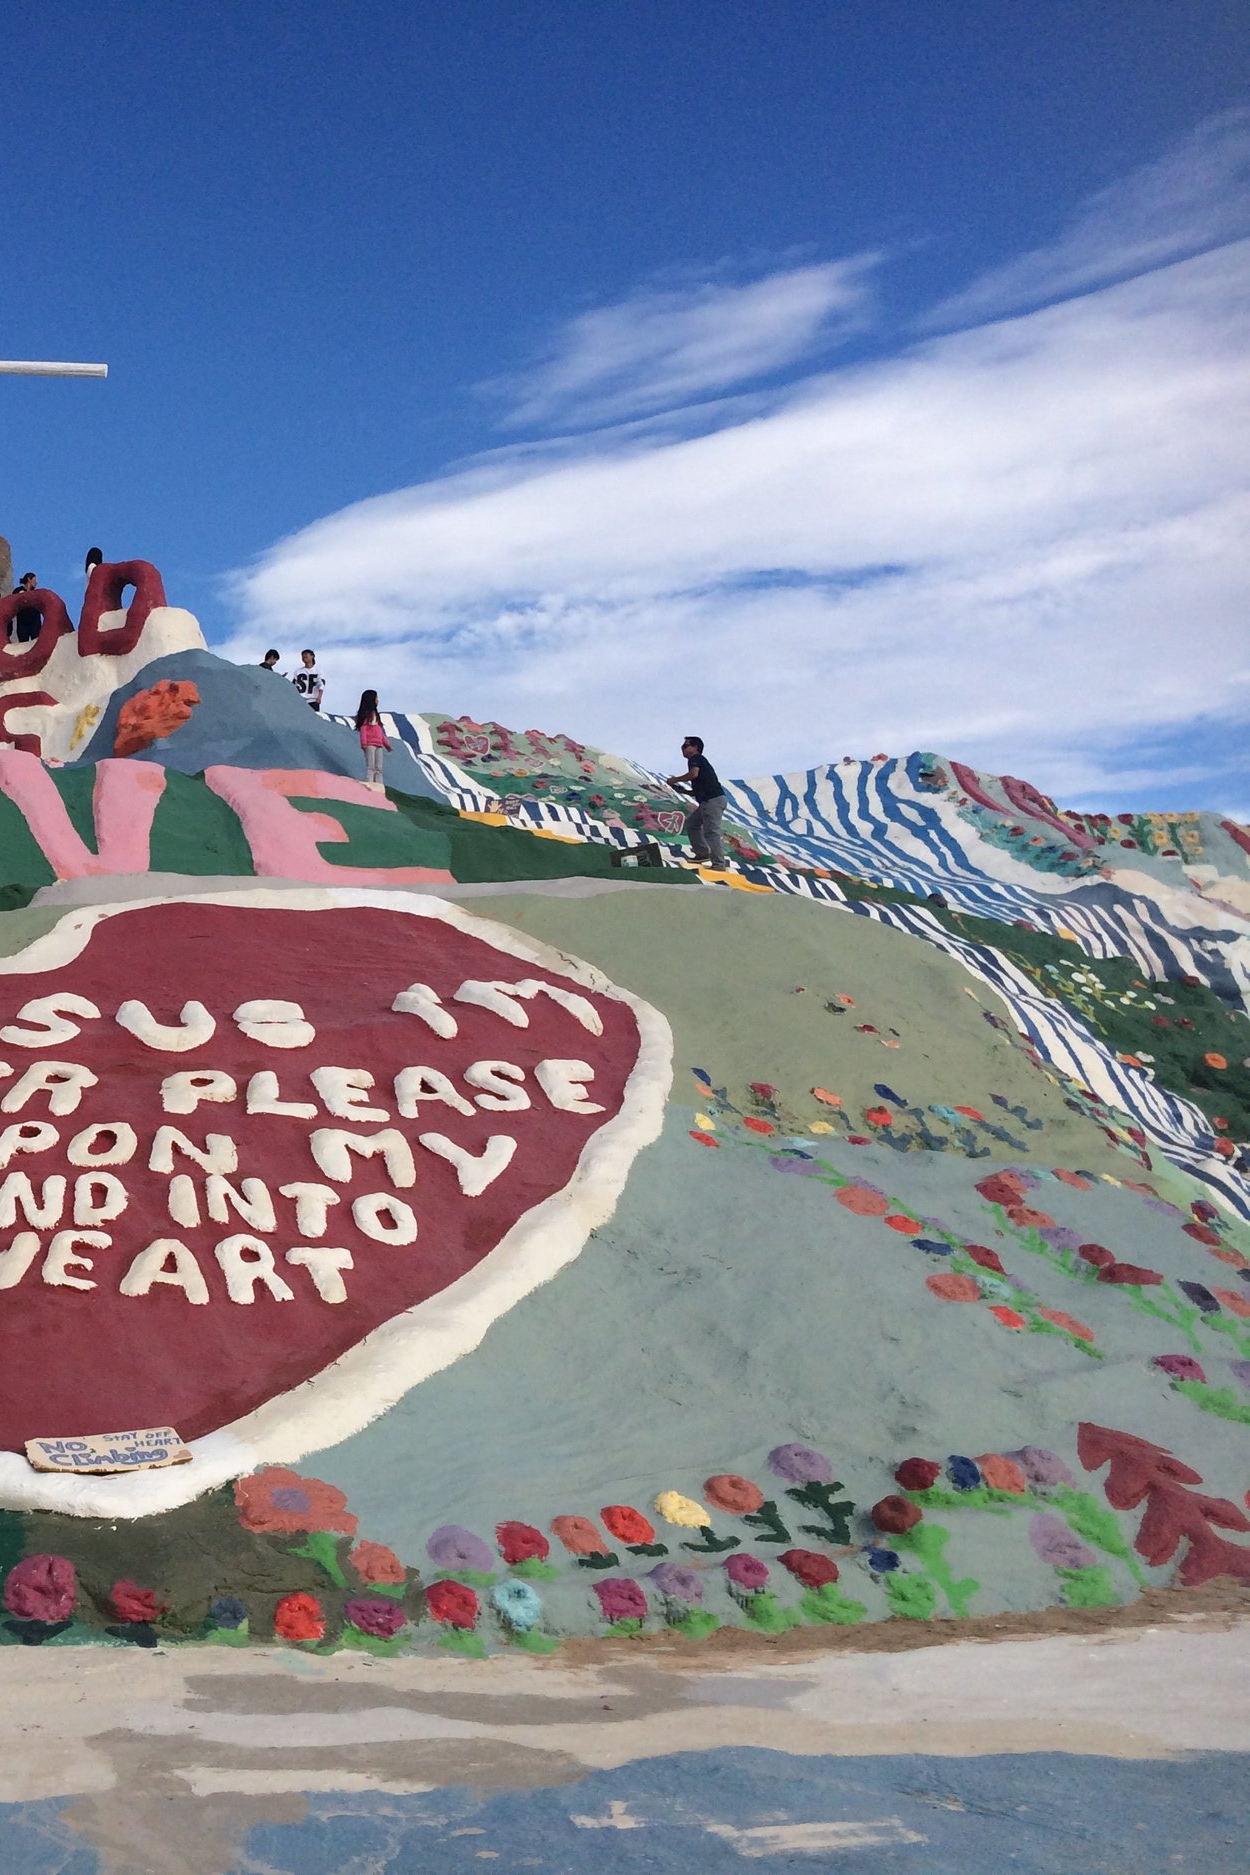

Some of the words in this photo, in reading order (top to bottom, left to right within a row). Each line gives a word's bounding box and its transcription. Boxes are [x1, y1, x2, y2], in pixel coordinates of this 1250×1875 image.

[296, 673, 318, 694] SF
[161, 1058, 606, 1123] PLEASE
[310, 1126, 518, 1198] MY
[168, 1173, 419, 1247] INTO
[36, 1441, 88, 1454] NO
